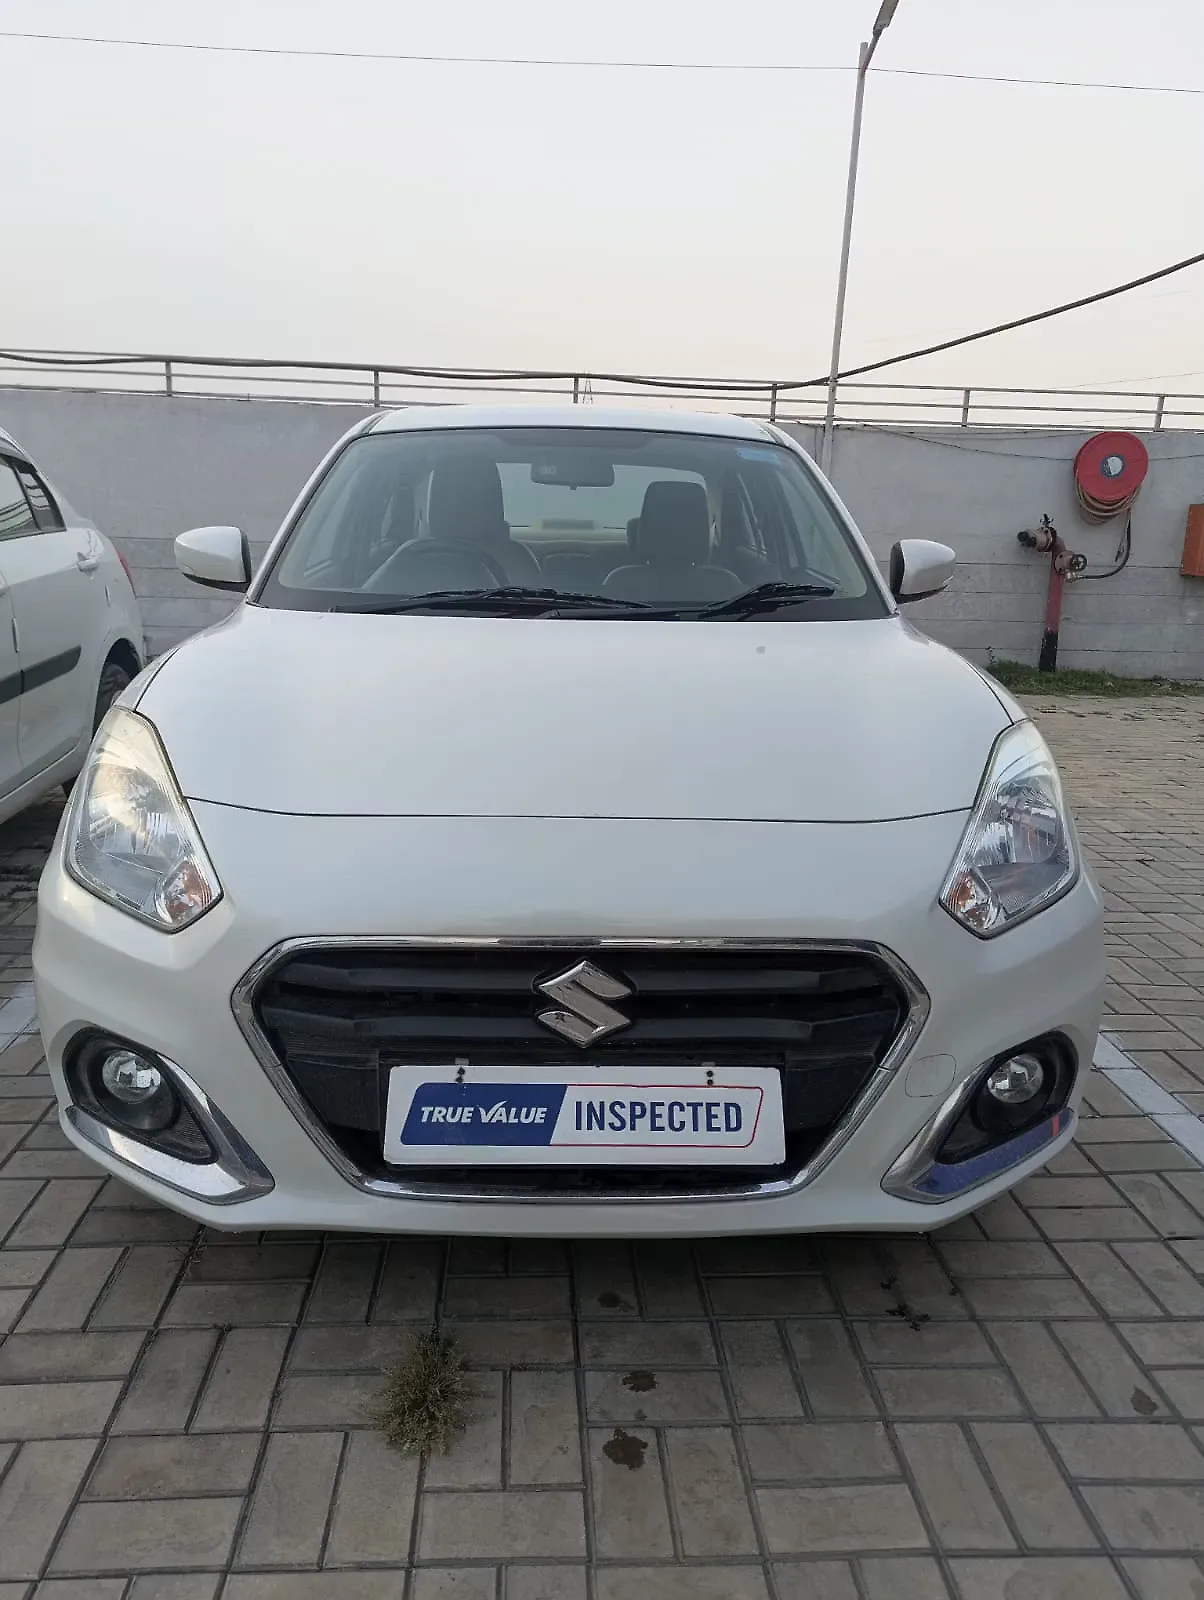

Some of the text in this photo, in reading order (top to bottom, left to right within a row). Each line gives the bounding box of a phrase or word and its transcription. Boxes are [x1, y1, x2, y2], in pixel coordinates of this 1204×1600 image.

[421, 1100, 742, 1132] TRUE VALUE INSPECTED
